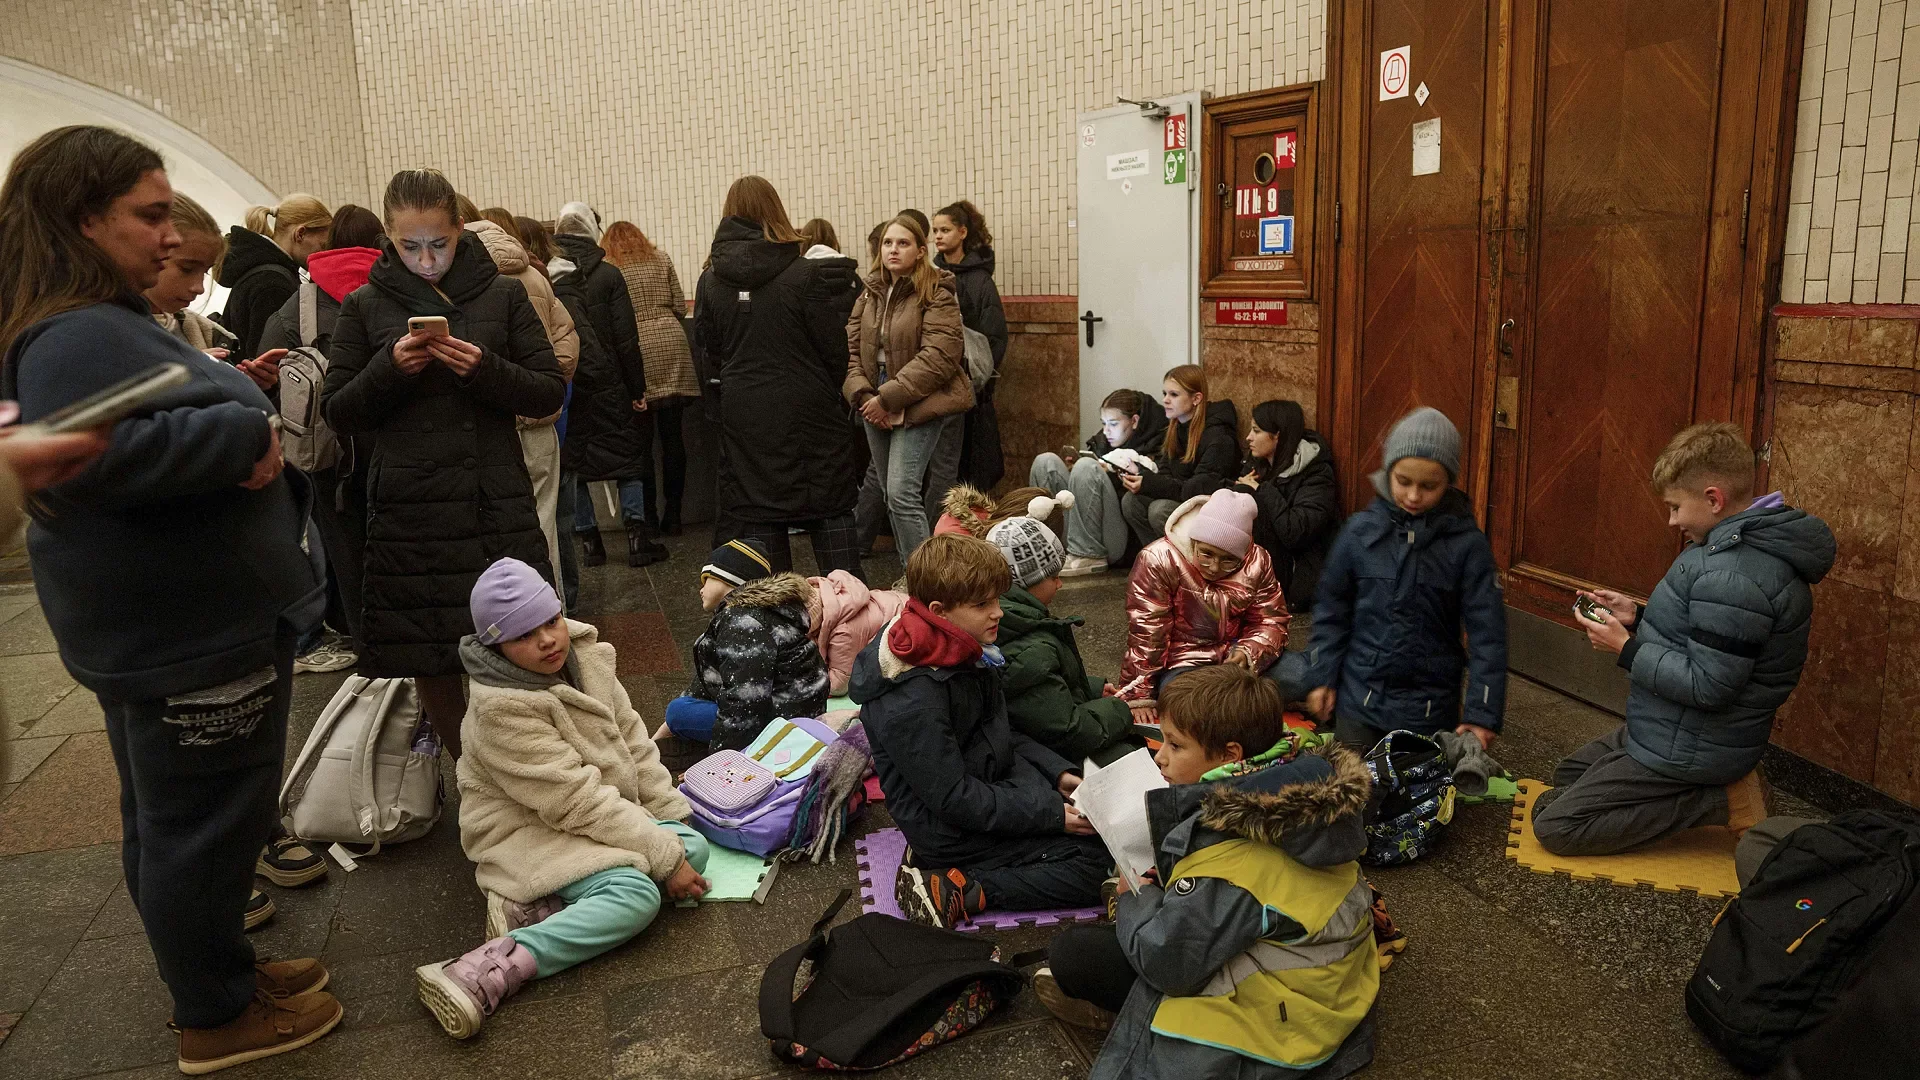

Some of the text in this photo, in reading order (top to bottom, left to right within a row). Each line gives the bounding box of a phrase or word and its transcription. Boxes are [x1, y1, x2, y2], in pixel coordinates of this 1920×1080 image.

[1267, 187, 1277, 213] 9
[1235, 260, 1284, 270] СУХОТРУБ
[1219, 301, 1230, 311] ПРИ
[1254, 301, 1284, 311] ДЗВОНИТИ
